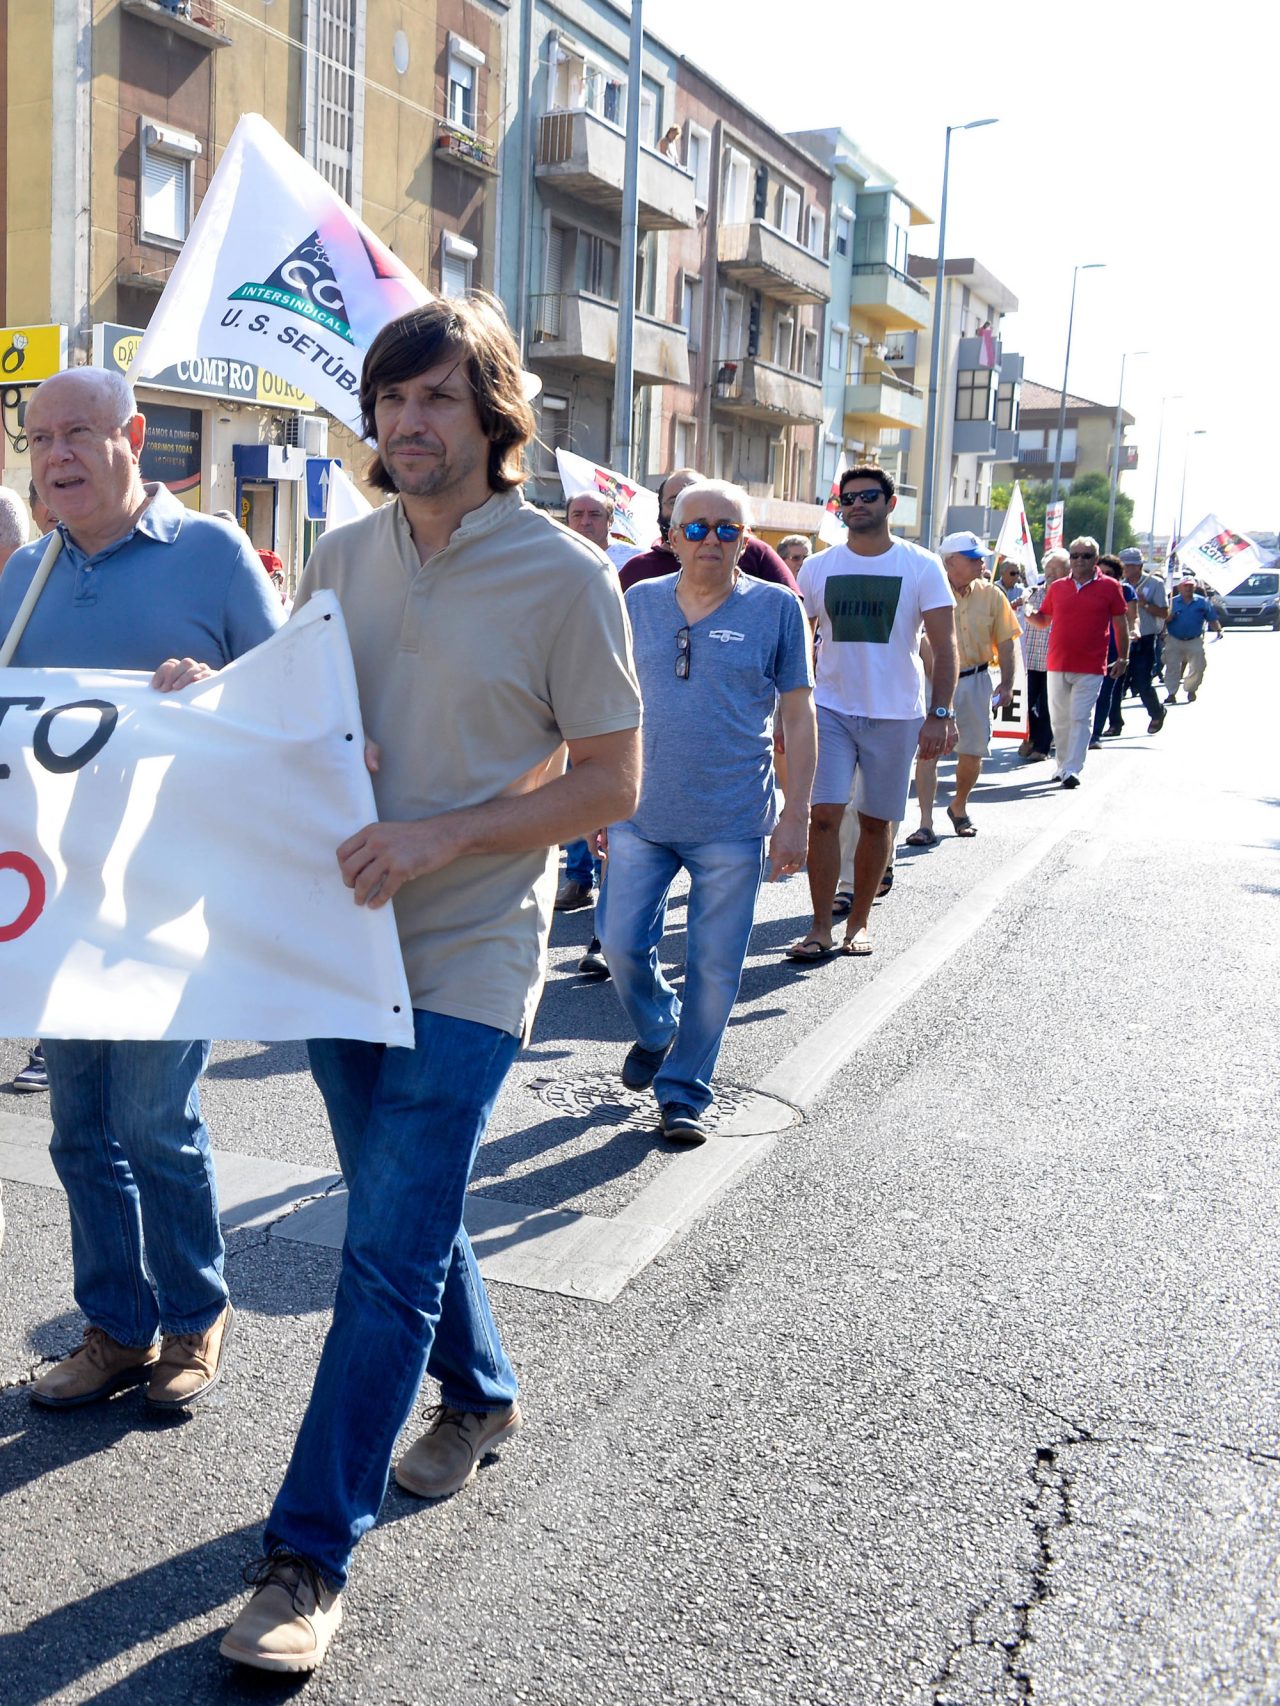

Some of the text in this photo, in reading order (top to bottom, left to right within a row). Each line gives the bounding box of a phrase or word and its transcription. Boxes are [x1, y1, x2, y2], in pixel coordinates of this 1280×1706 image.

[220, 308, 243, 328] U.
[248, 314, 270, 335] S.
[241, 286, 341, 332] INTERSINDICAL
[176, 357, 254, 391] COMPRO
